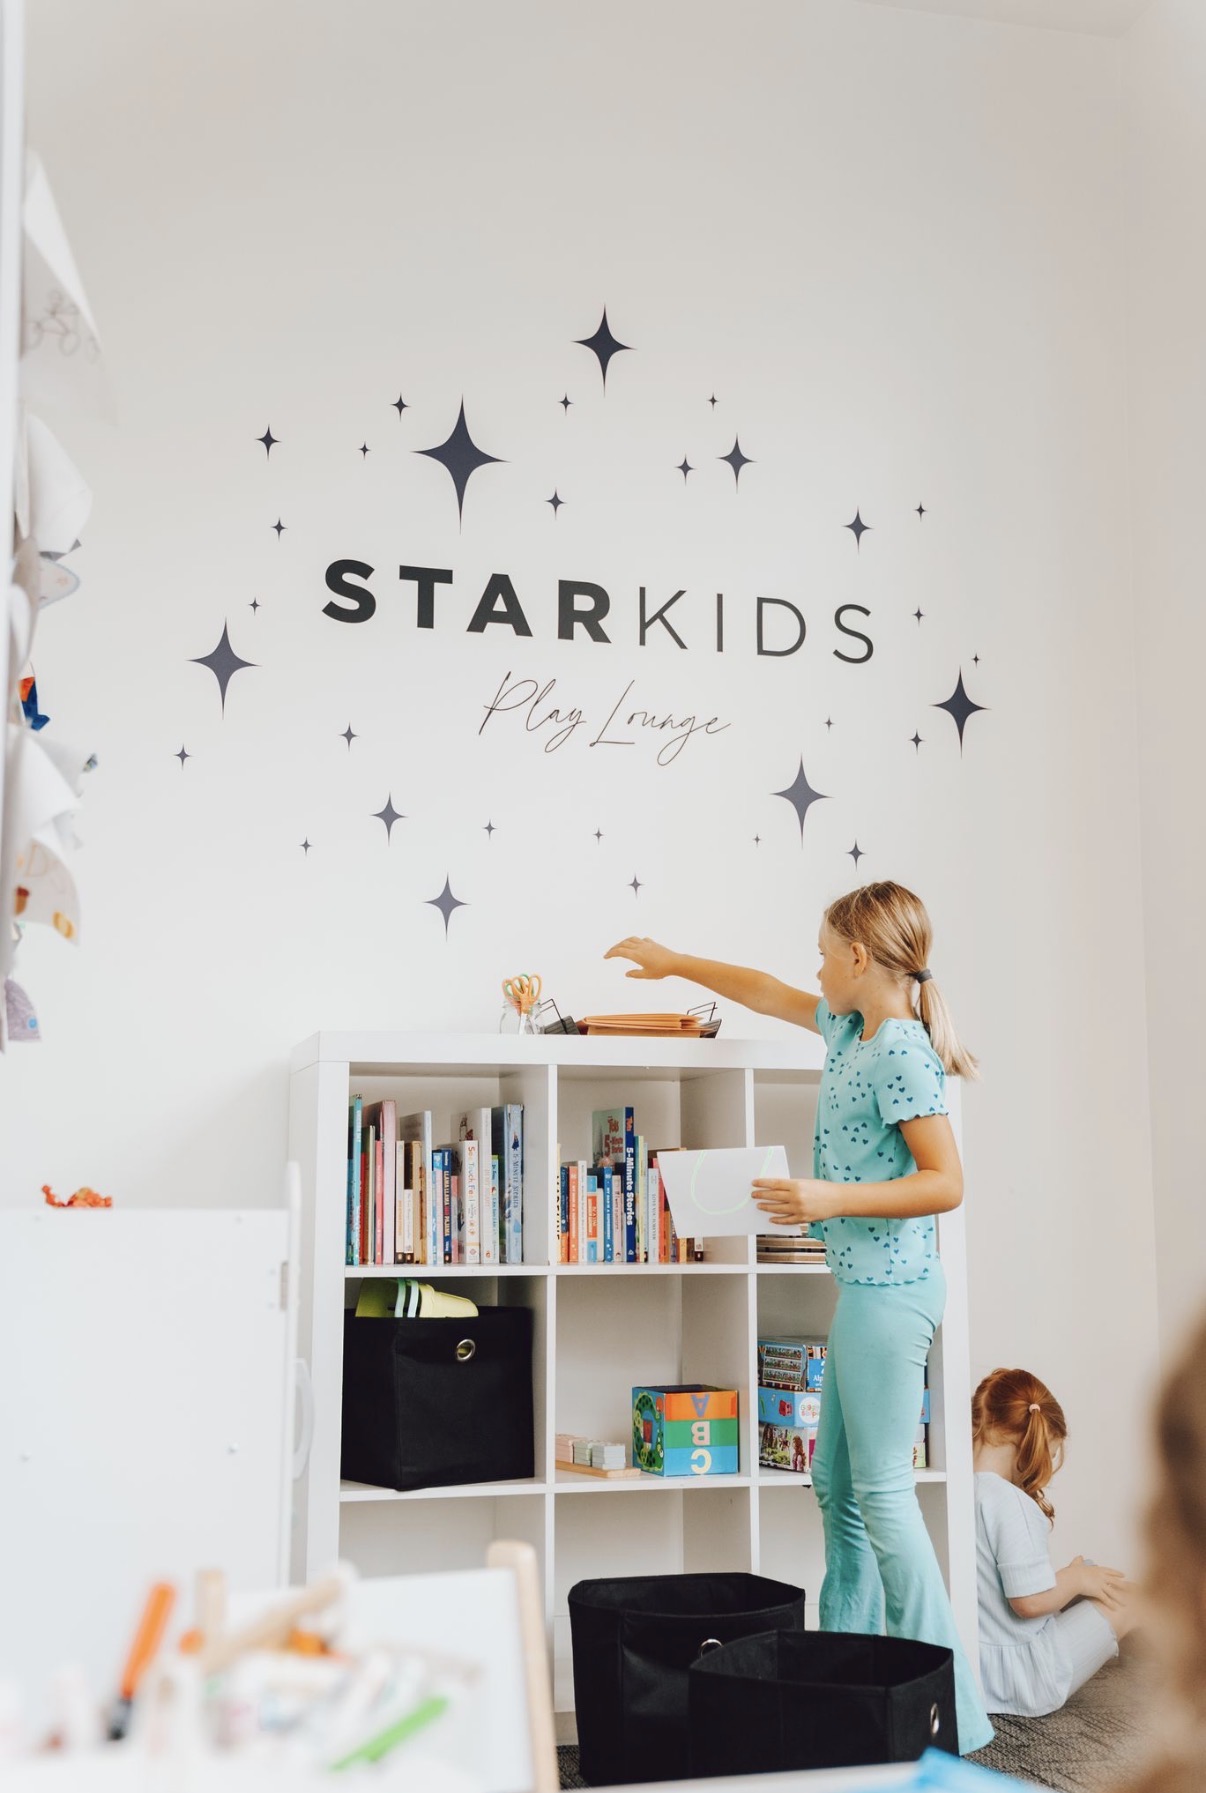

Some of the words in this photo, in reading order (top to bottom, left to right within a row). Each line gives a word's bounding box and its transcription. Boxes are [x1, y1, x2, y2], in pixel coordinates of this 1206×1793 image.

[321, 558, 875, 664] STARKIDS
[478, 671, 587, 754] Play
[588, 679, 731, 767] Lounge
[625, 1147, 635, 1191] 5-Minute
[625, 1192, 635, 1226] Stories
